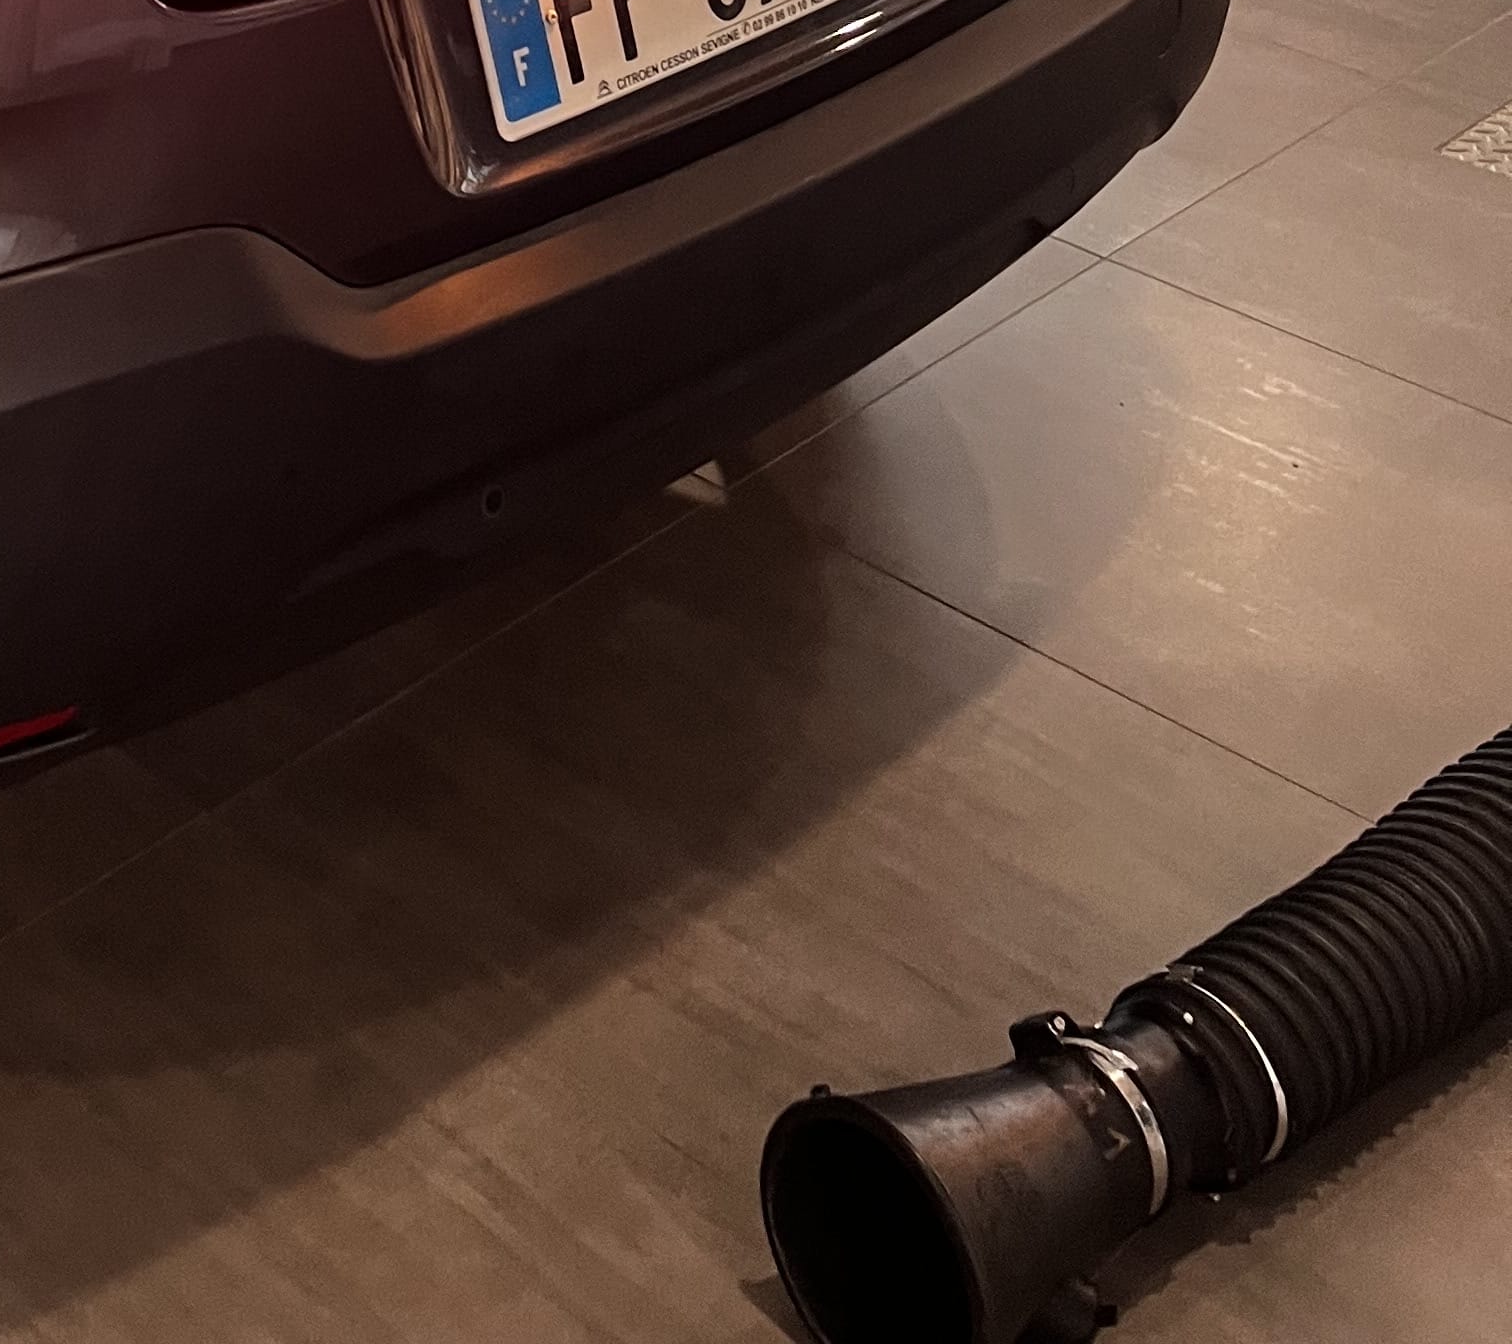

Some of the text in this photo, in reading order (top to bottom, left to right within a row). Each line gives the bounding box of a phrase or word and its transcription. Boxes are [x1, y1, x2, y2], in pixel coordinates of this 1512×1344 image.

[512, 45, 530, 88] F
[616, 63, 660, 91] CITROEN
[660, 45, 700, 72] CESSON
[700, 28, 741, 56] SEVIGNE
